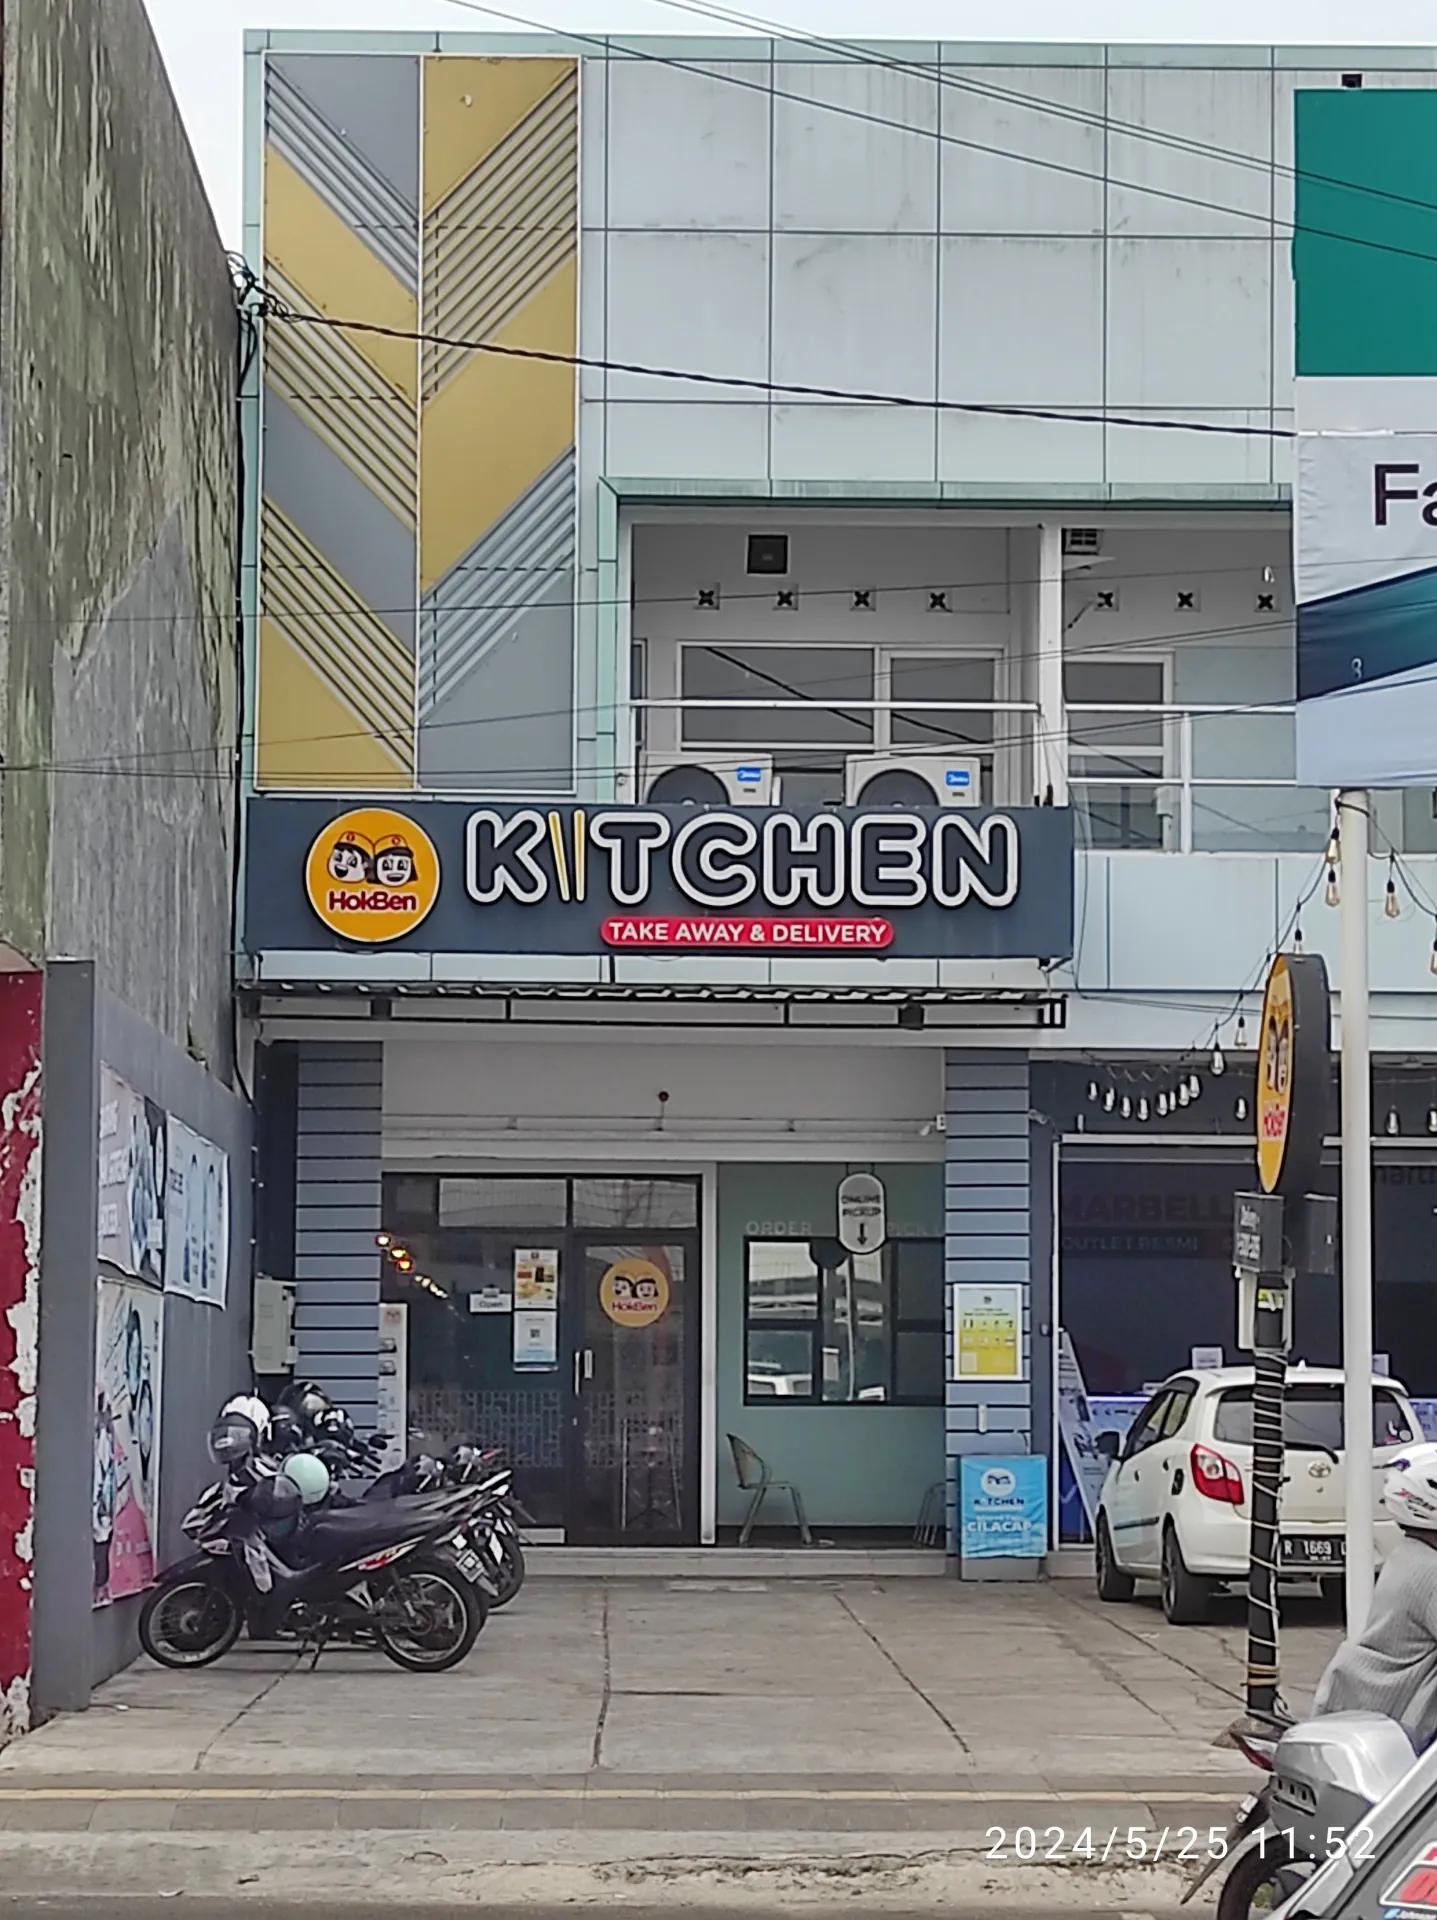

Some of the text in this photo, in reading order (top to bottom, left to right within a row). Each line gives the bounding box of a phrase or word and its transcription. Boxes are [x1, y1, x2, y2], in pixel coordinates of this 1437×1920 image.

[465, 809, 1020, 907] KITCHEN
[328, 890, 417, 912] HokBen
[609, 922, 888, 944] TAKE AWAY & DELIVERY
[745, 1220, 812, 1236] ORDER
[967, 1521, 1033, 1533] CILACAP
[1283, 1540, 1293, 1555] R
